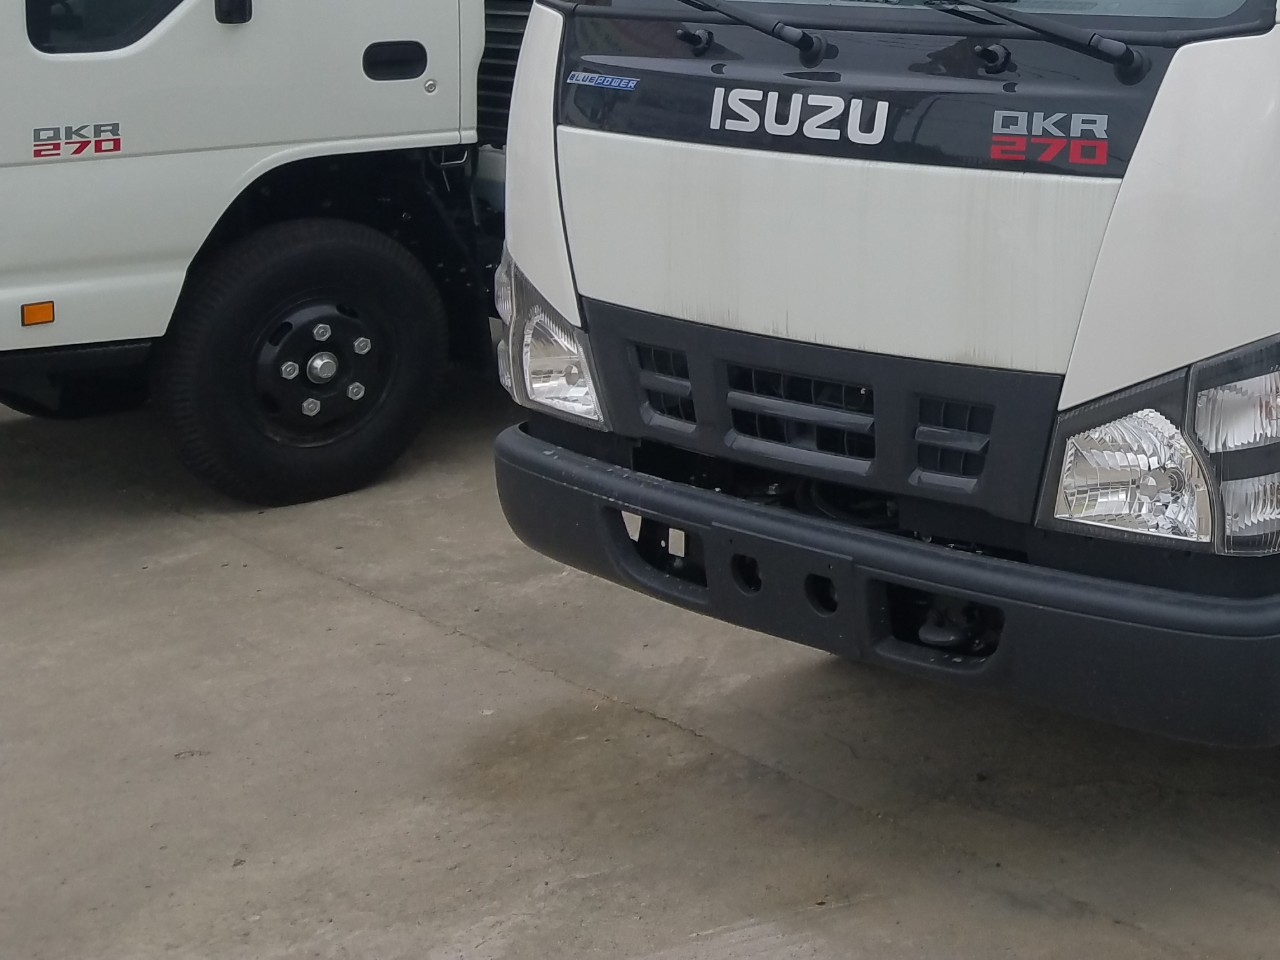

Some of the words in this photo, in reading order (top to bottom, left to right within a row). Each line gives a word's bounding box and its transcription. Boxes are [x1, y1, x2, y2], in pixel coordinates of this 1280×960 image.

[709, 87, 890, 145] ISUZU
[992, 109, 1109, 139] QKR
[33, 123, 120, 142] QKR
[33, 138, 121, 158] 270
[990, 135, 1109, 166] 270
